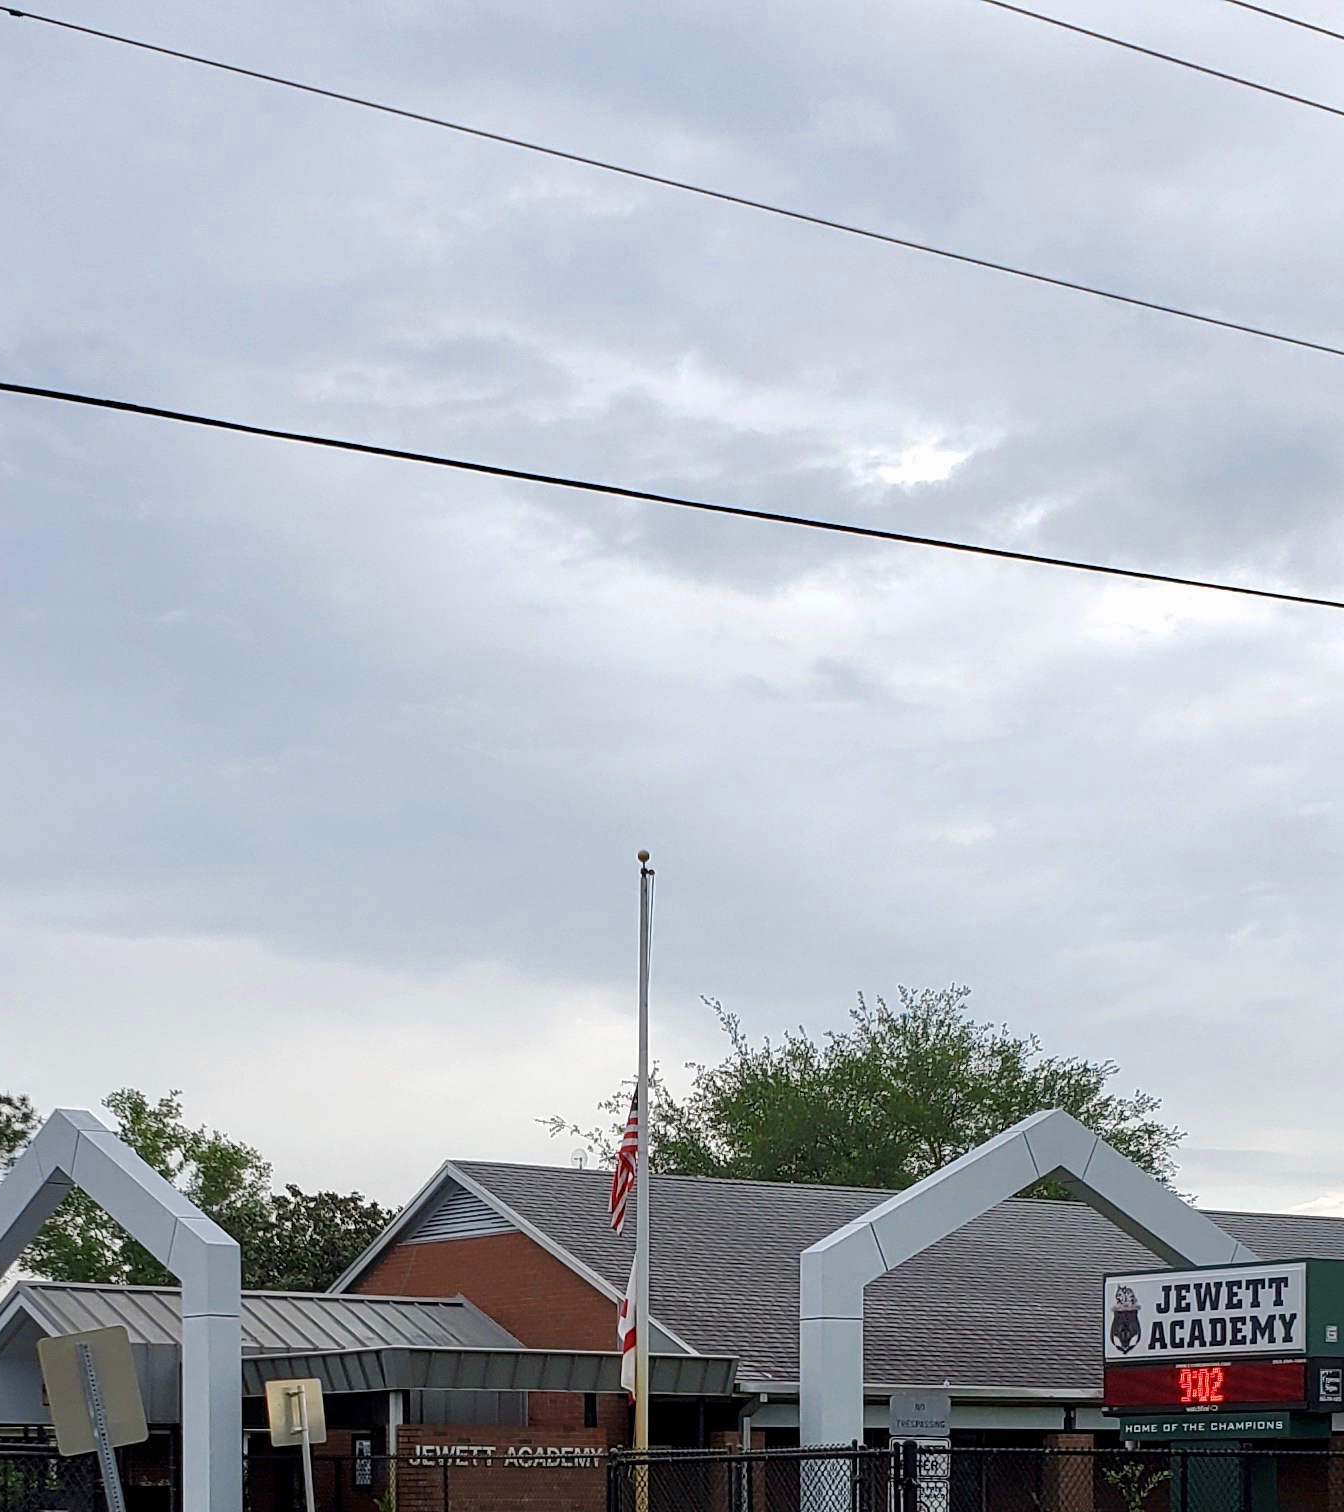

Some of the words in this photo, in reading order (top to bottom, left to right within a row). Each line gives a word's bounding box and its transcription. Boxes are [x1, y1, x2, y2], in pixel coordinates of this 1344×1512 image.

[1155, 1276, 1289, 1314] JEWETT
[1148, 1313, 1297, 1350] ACADEMY
[1179, 1367, 1224, 1402] 9:02
[915, 1403, 925, 1411] NO
[896, 1419, 946, 1428] TRESPASSING
[1125, 1424, 1158, 1433] HOME
[1162, 1423, 1178, 1432] OF
[1182, 1422, 1205, 1432] THE
[1210, 1420, 1284, 1431] CHAMPIONS
[409, 1445, 497, 1467] JEWETT
[504, 1446, 603, 1467] ACADEMY
